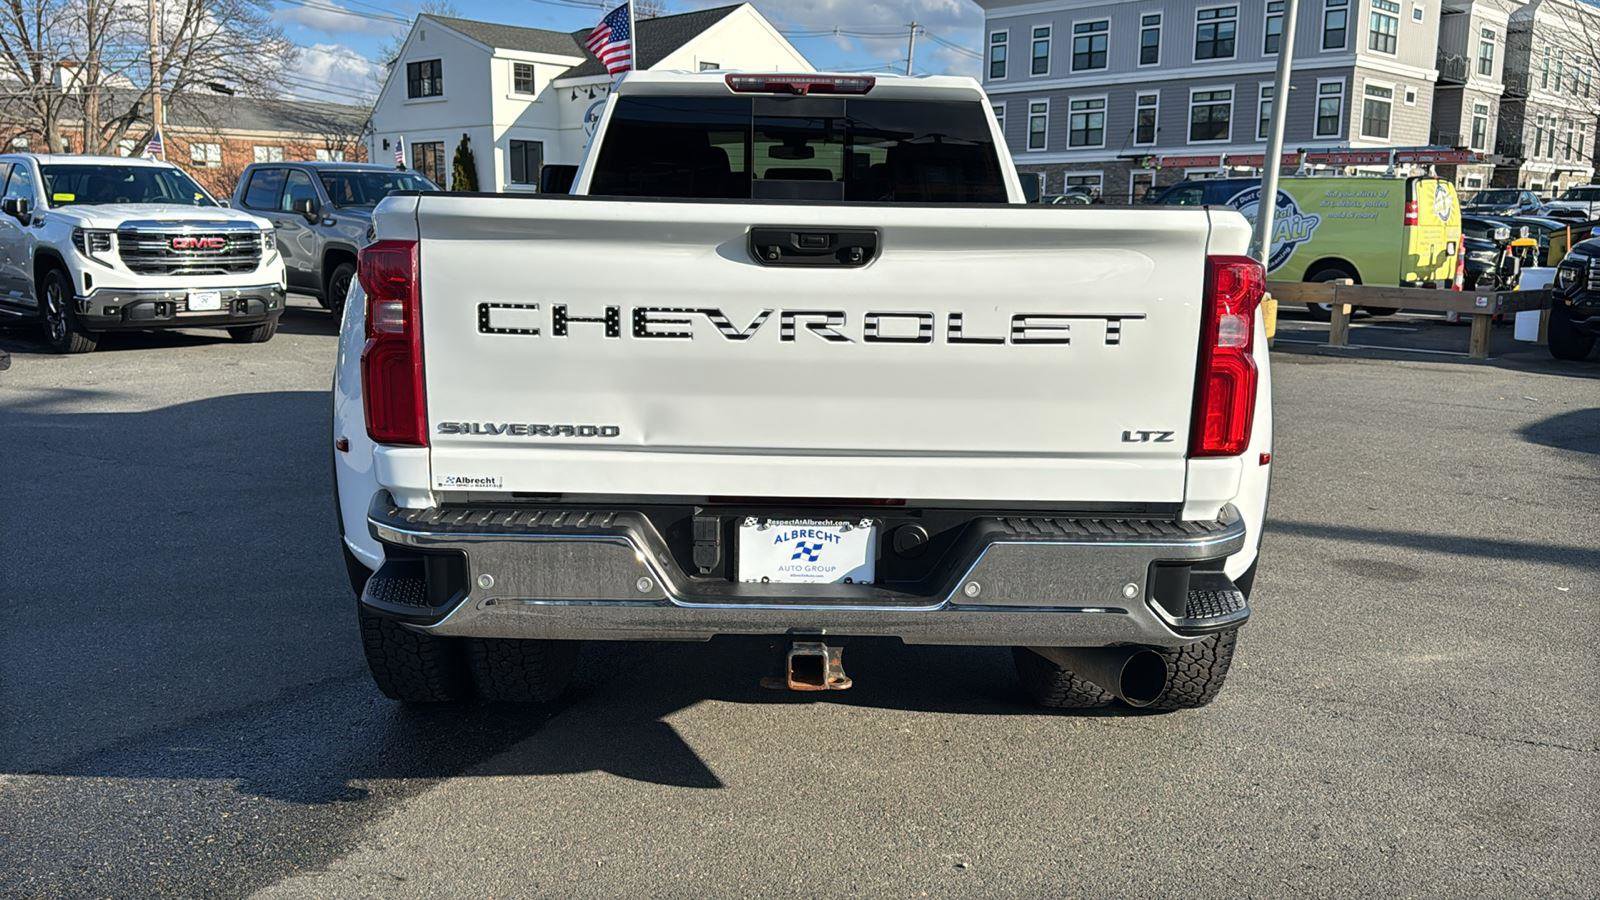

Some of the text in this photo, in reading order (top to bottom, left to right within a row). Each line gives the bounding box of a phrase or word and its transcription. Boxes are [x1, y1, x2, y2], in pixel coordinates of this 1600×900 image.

[1275, 216, 1316, 242] Air
[172, 237, 225, 249] GMC
[477, 302, 1147, 345] CHEVROLET
[437, 421, 620, 438] SILVERADO
[1121, 430, 1175, 443] LTZ
[455, 476, 495, 484] Albrecht
[767, 518, 850, 527] RespectAtAlbrecht.com
[775, 529, 841, 545] ALBRECHT
[804, 565, 836, 573] GROUP
